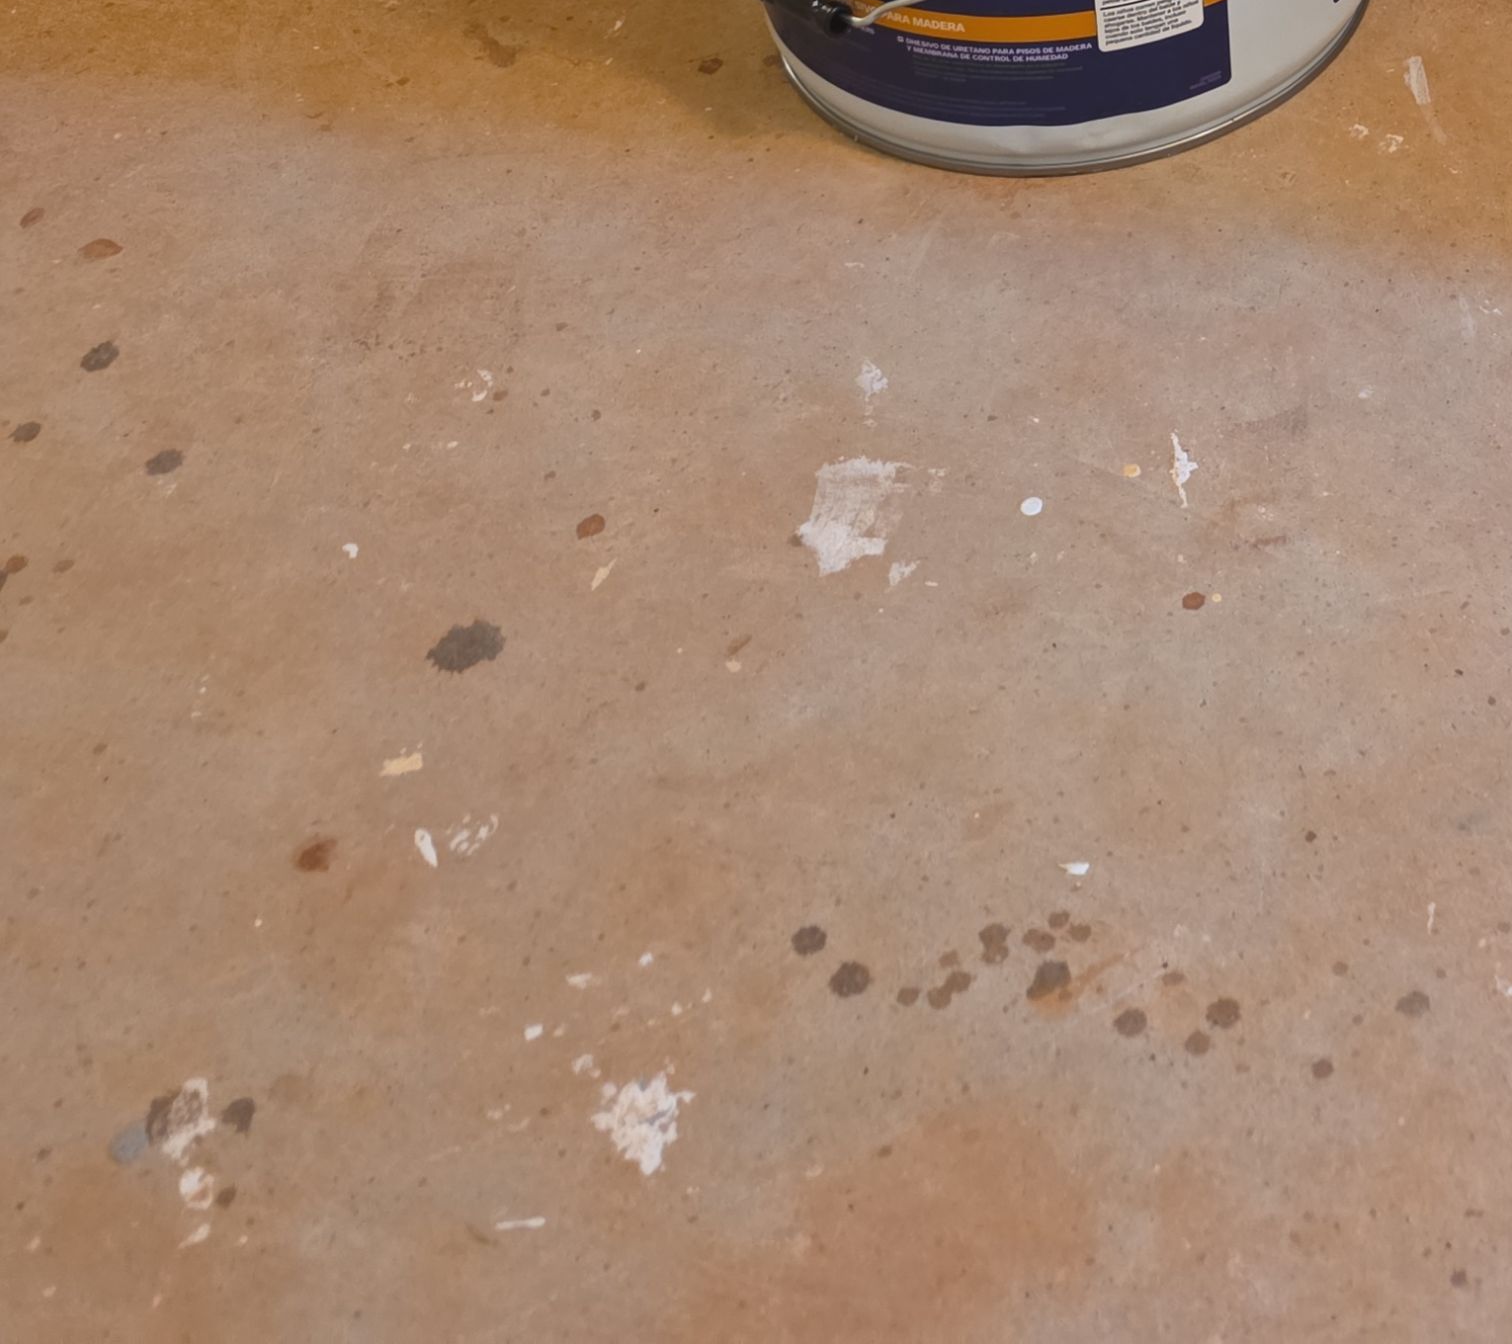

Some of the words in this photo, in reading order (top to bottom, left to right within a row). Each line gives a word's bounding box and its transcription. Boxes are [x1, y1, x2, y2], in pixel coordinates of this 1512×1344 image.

[913, 17, 965, 32] MADERA
[1056, 43, 1092, 53] MADERA
[1026, 53, 1068, 62] HUMEDAD
